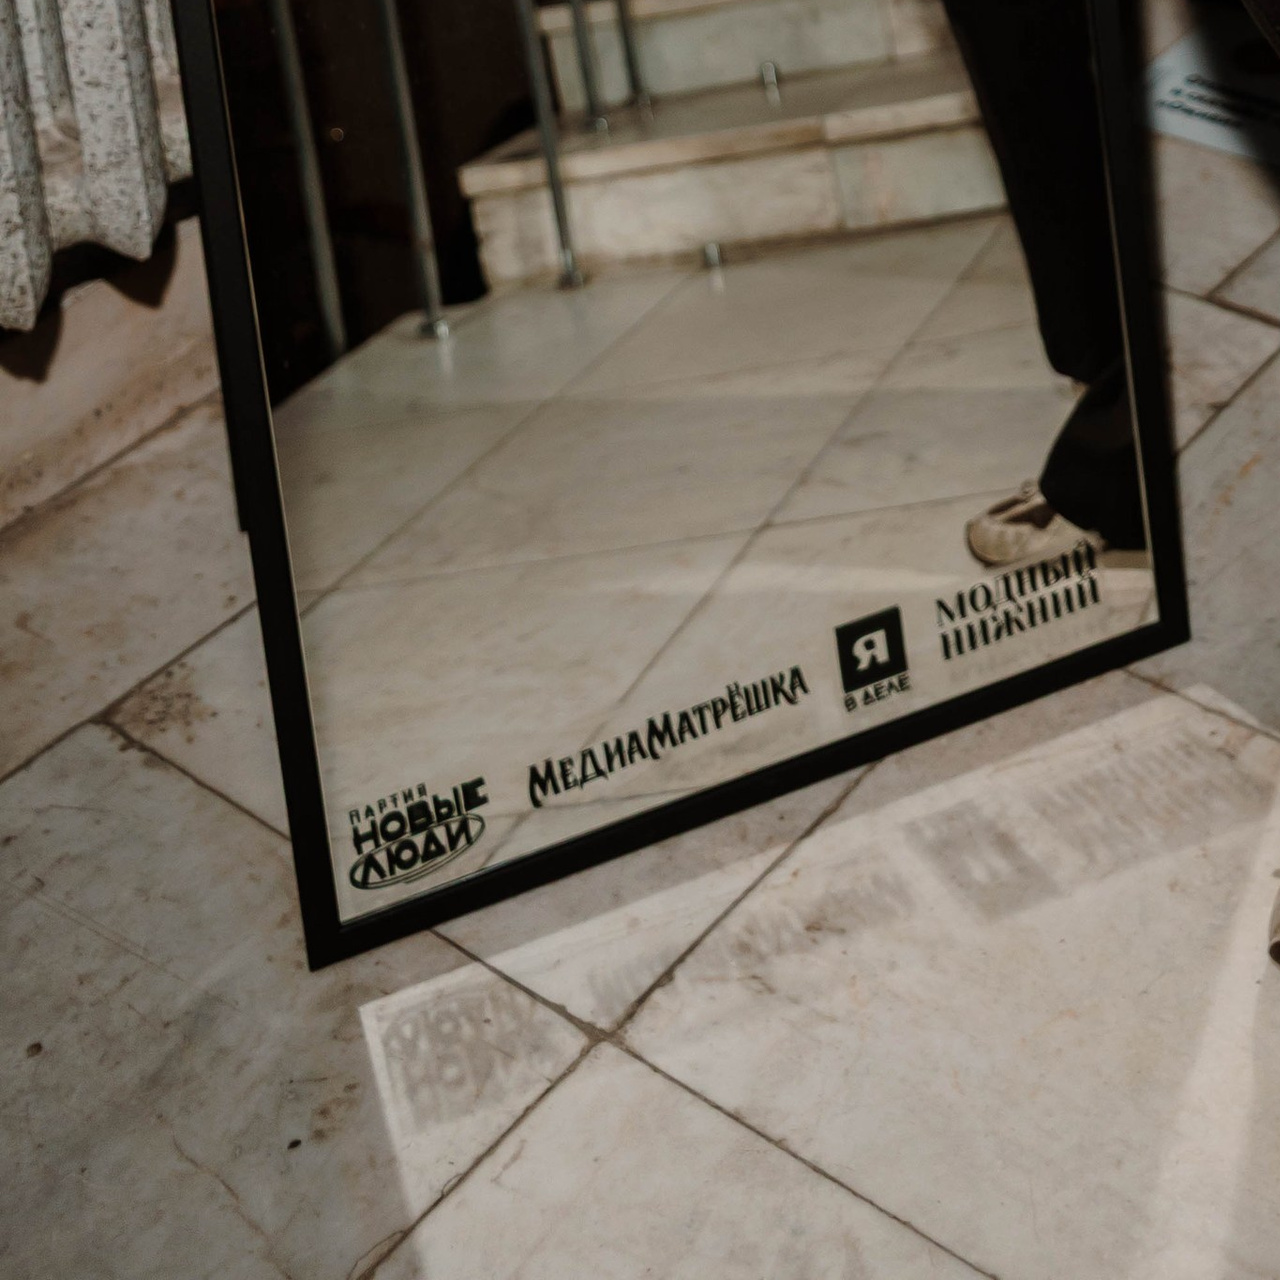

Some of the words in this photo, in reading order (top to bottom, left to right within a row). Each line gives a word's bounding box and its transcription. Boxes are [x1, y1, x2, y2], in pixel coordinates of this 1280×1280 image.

[935, 539, 1097, 626] МОДНЫЙ
[940, 568, 1101, 660] НИЖНИЙ
[852, 628, 890, 672] Я
[844, 692, 857, 713] В
[863, 673, 911, 706] ДЕЛЕ
[349, 782, 428, 825] ПАРТИЯ
[352, 776, 489, 855] НОВЫЕ
[362, 815, 473, 885] ЛЮДИ
